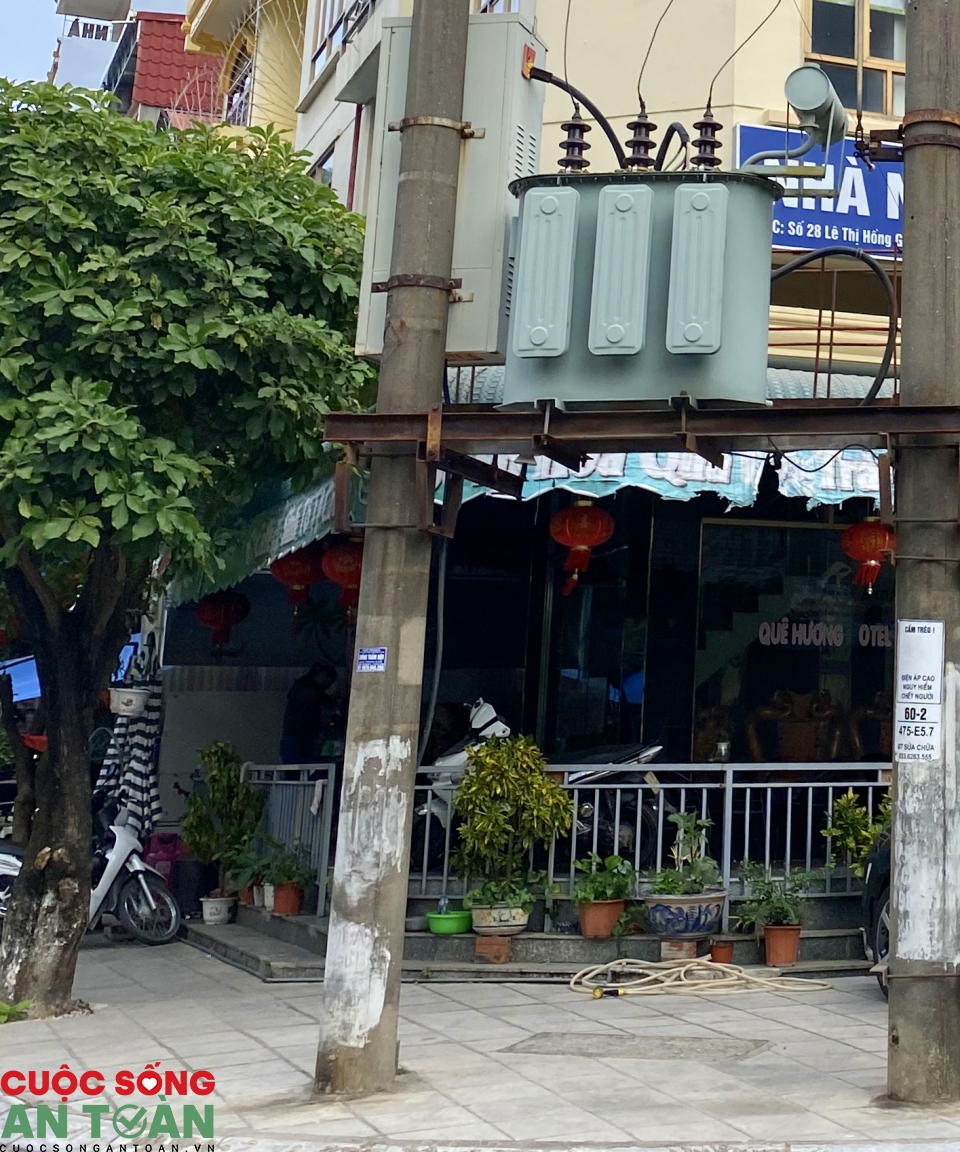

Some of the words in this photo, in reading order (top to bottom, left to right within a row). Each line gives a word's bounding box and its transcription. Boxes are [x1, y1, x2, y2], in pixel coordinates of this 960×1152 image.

[764, 156, 871, 217] NHÀ
[772, 219, 784, 234] C:
[788, 219, 805, 236] Số
[807, 223, 822, 239] 28
[825, 224, 839, 241] Lê
[842, 227, 860, 246] Thị
[863, 227, 892, 248] Hồng
[758, 616, 790, 647] QUÊ
[791, 620, 845, 647] HƯƠNG
[922, 674, 935, 682] CAO
[904, 707, 927, 721] 60-2
[898, 725, 935, 737] 475-E5.7
